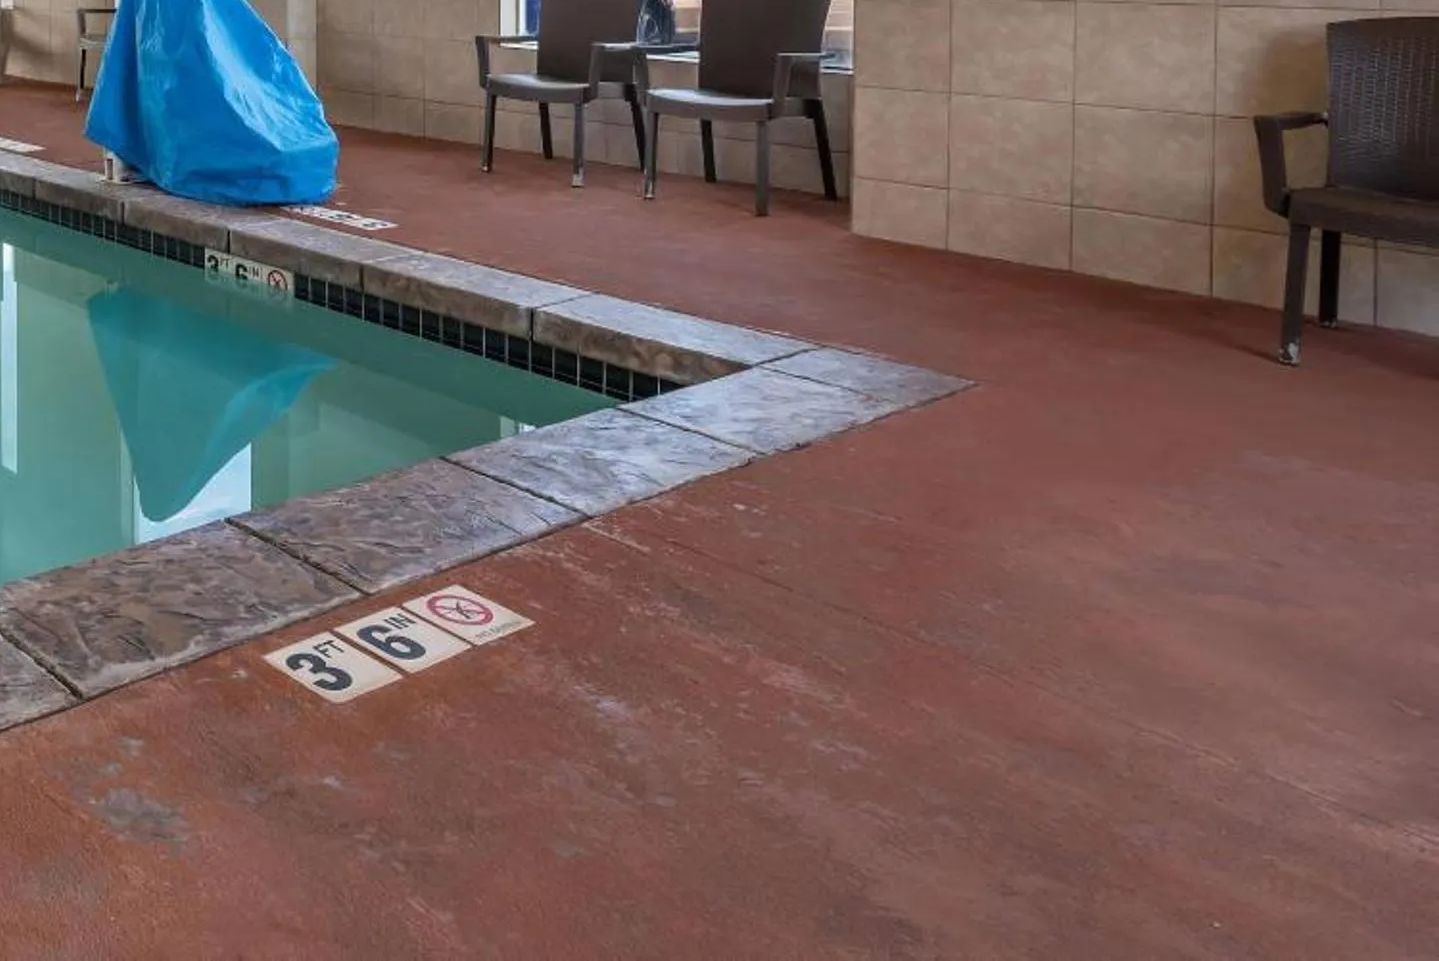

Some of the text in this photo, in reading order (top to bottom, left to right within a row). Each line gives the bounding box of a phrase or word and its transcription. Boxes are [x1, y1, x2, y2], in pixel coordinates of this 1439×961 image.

[285, 613, 427, 692] 3 FT 6 IN
